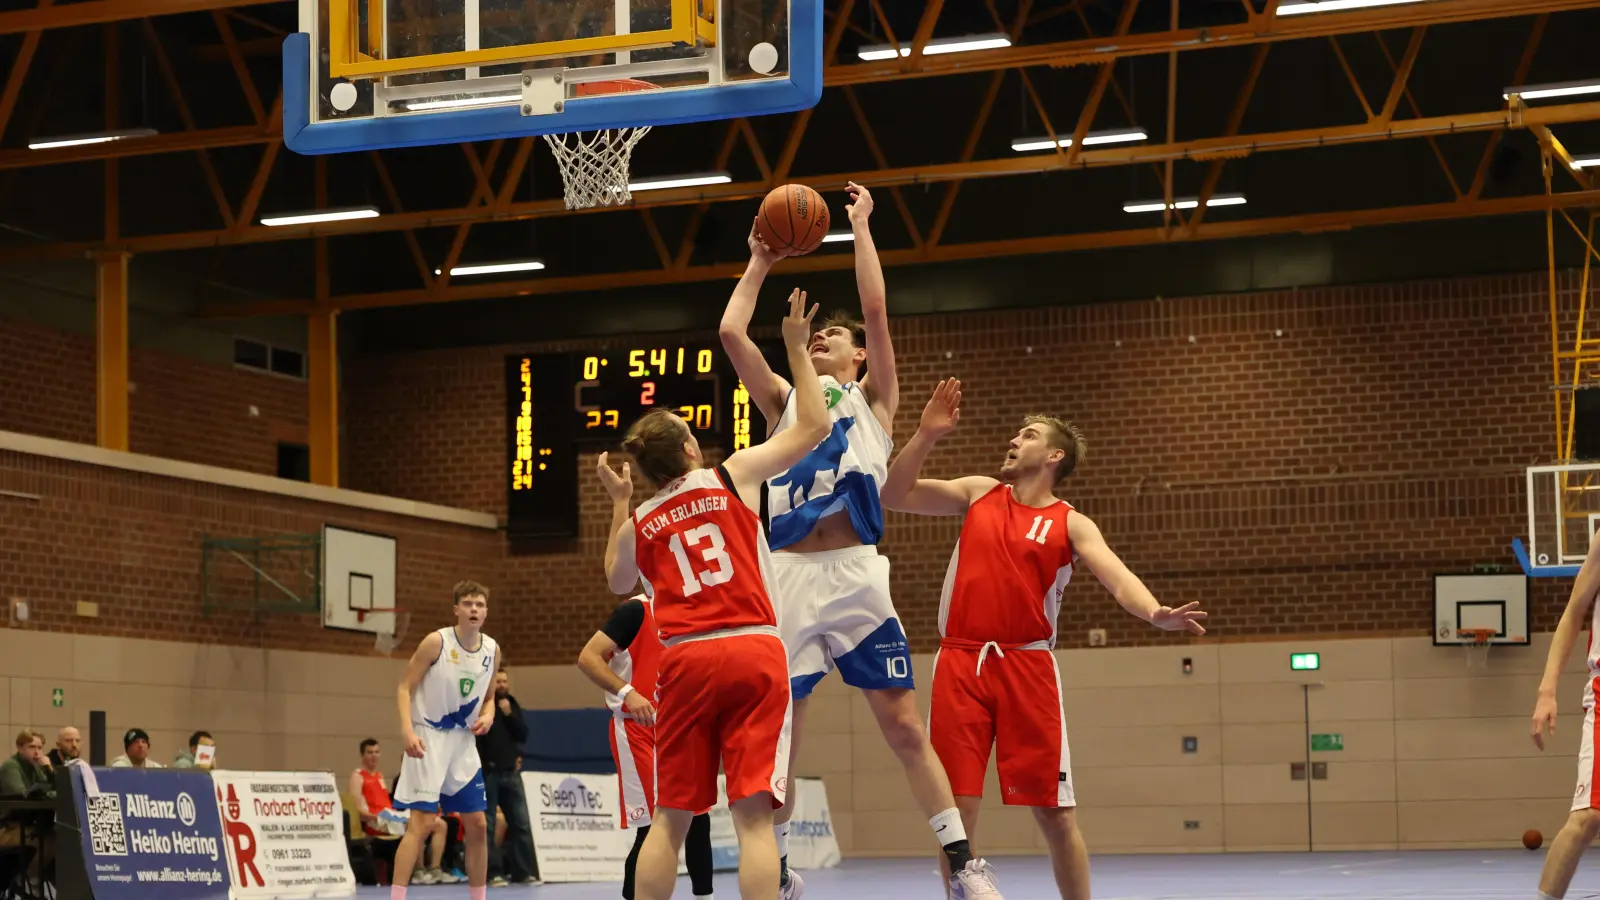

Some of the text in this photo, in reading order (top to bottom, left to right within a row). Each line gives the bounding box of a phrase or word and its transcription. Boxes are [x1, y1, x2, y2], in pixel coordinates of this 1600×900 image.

[520, 358, 531, 372] 2
[583, 356, 599, 380] 0
[640, 381, 656, 405] 2
[641, 496, 729, 540] CVJM ERLANGEN
[1025, 515, 1054, 545] 11
[668, 522, 735, 598] 13
[886, 656, 908, 679] 10
[126, 793, 177, 819] Allianz
[253, 797, 335, 820] Norbert Ringer
[540, 783, 603, 814] Sleep Tec
[130, 828, 219, 862] Heiko Hering
[272, 848, 289, 859] 0961
[136, 867, 223, 886] www.allianz-hering.de
